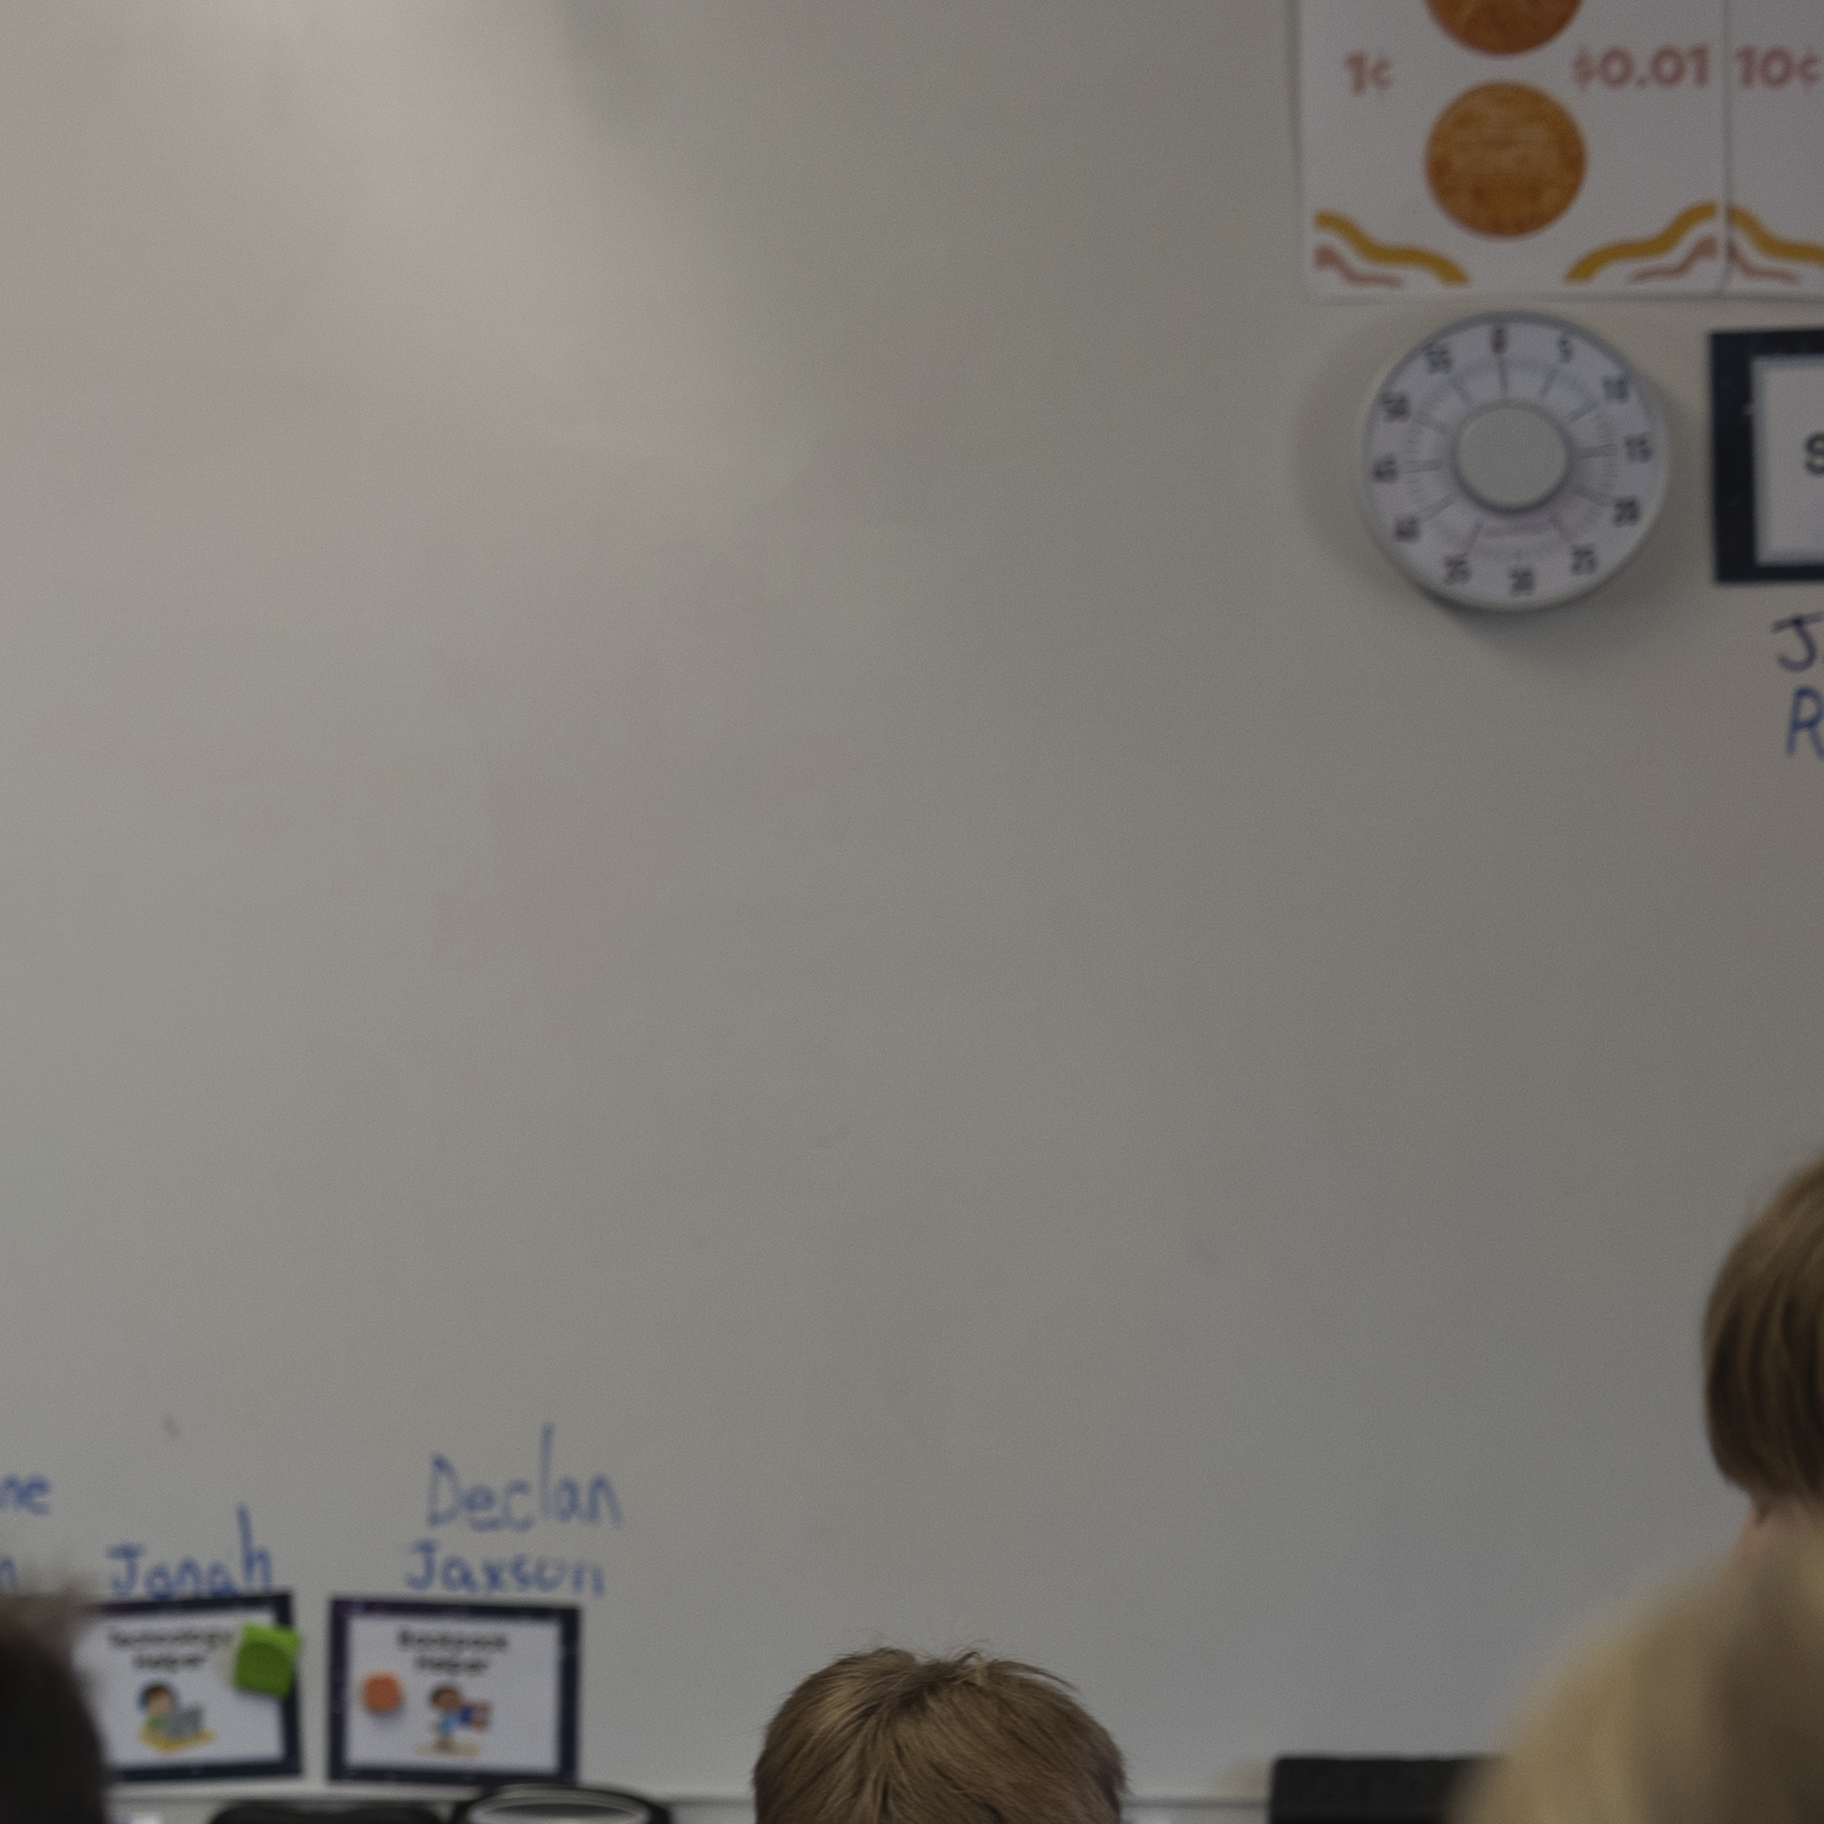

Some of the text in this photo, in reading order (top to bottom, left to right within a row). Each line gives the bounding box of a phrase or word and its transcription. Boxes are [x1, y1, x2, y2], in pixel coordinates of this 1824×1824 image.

[1344, 51, 1394, 97] 1¢
[1572, 42, 1711, 92] $0.01
[1734, 44, 1821, 94] 10¢
[1772, 612, 1824, 673] J
[426, 1423, 623, 1533] Declan
[105, 1502, 274, 1598] Jonah
[404, 1537, 608, 1597] Jaxson
